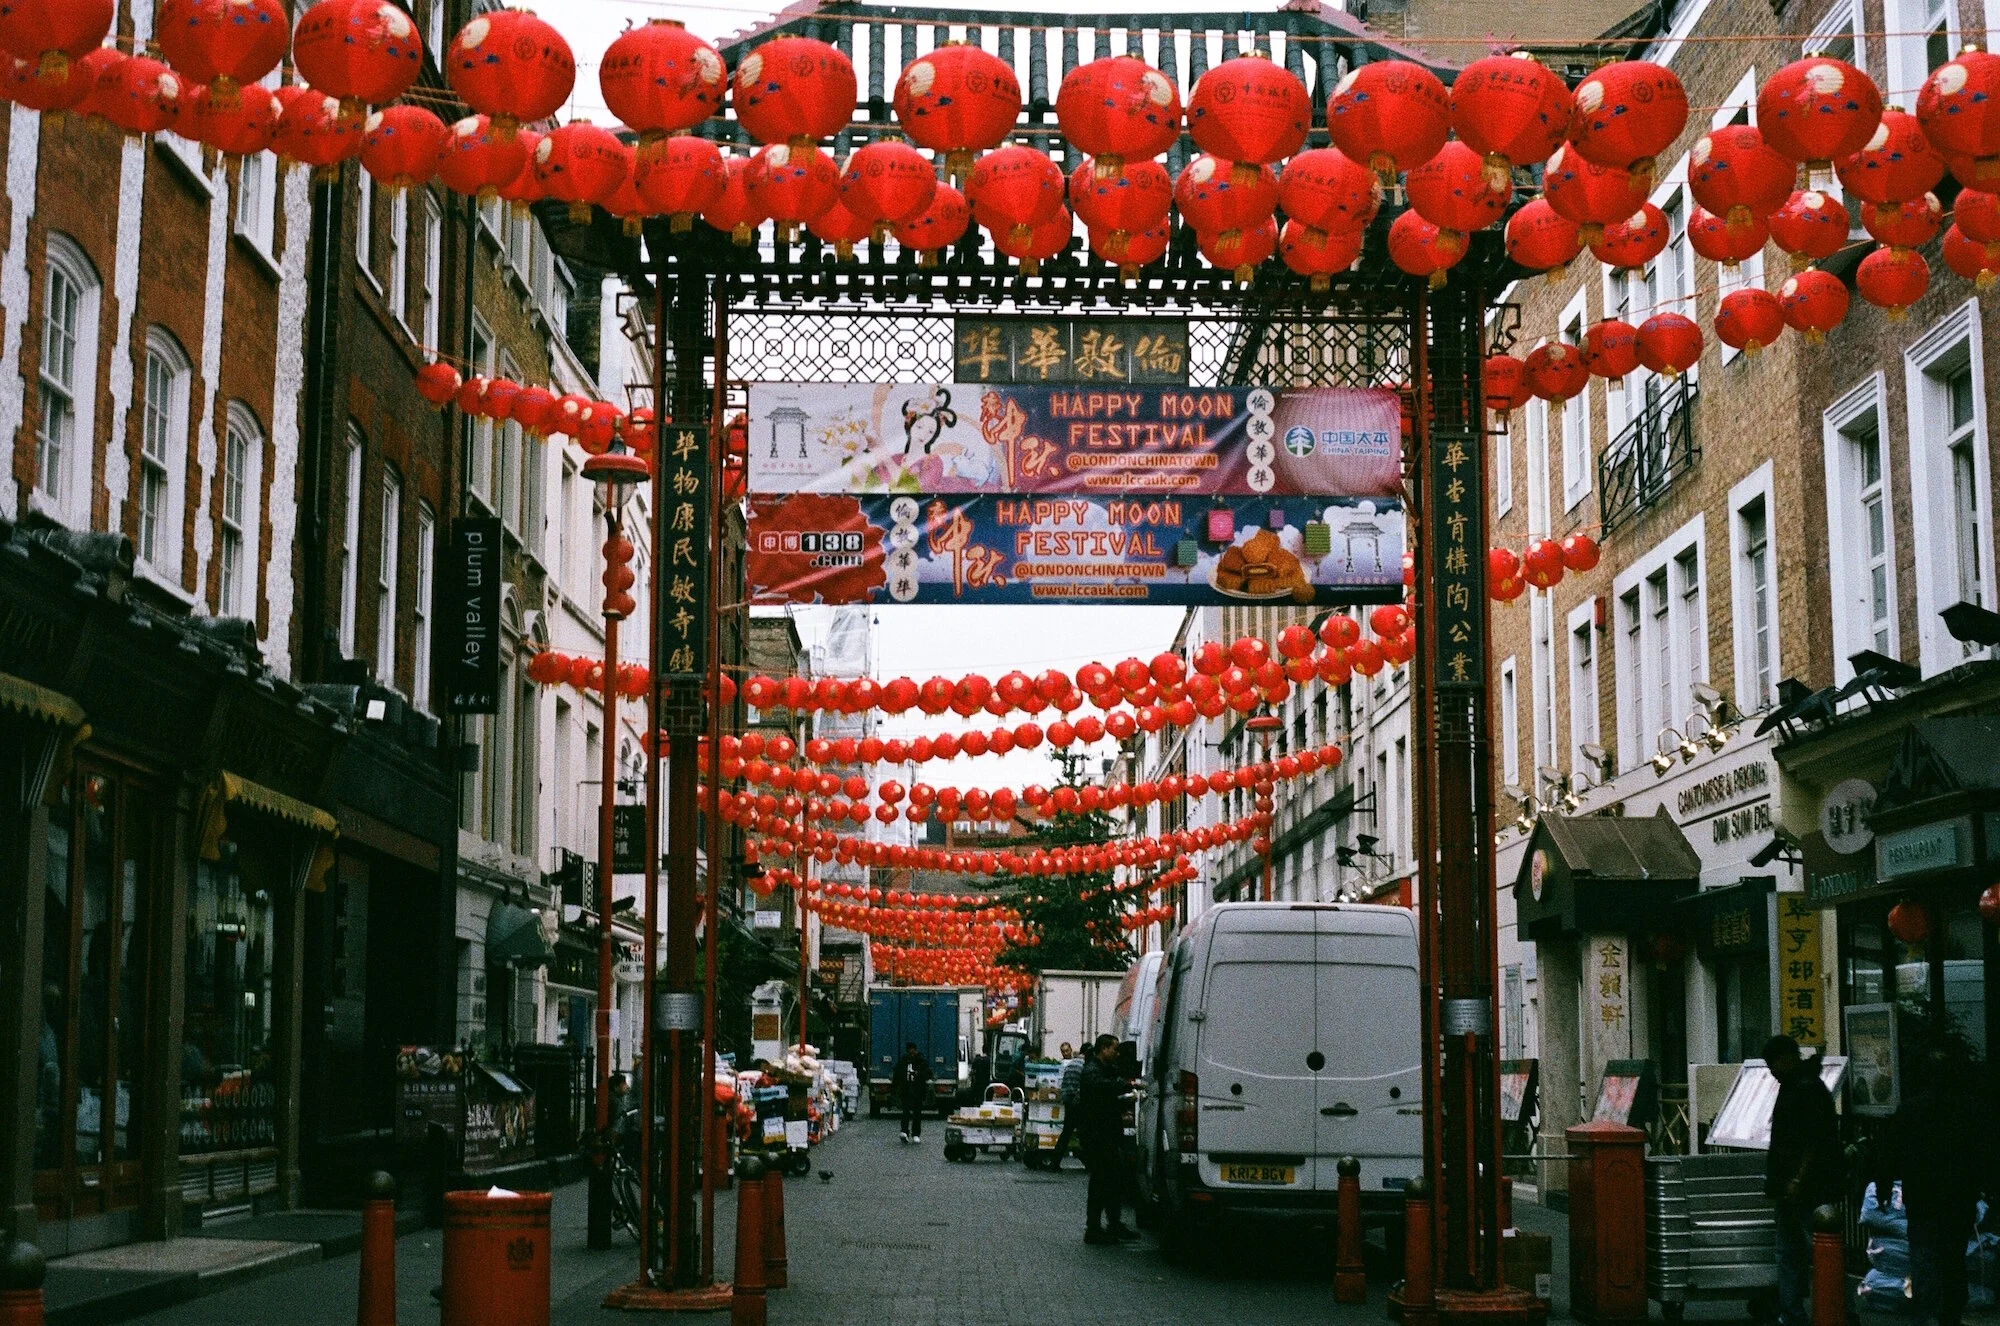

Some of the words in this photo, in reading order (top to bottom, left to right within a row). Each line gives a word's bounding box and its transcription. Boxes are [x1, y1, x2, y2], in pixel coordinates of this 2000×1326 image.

[1050, 391, 1143, 418] HAPPY
[1161, 391, 1235, 419] MOON
[1069, 423, 1214, 447] FESTIVAL
[1321, 431, 1389, 445] 中国太平
[1067, 452, 1218, 469] @LONDONCHINATOWN
[1086, 474, 1199, 487] www.lccauk.com
[997, 501, 1089, 525] HAPPY
[1108, 501, 1182, 526] MOON
[1015, 531, 1164, 556] FESTIVAL
[465, 532, 488, 587] plum
[810, 554, 863, 567] .com
[1014, 563, 1166, 577] @LONDONCHINATOWN
[1032, 584, 1148, 598] www.lccauk.com
[462, 597, 487, 668] valley
[1678, 775, 1725, 814] CANTONESE
[1734, 762, 1767, 792] PEKING
[1713, 816, 1729, 843] DIM
[1731, 808, 1752, 838] SUM
[1229, 1164, 1259, 1180] KR12
[1261, 1164, 1287, 1181] BGV
